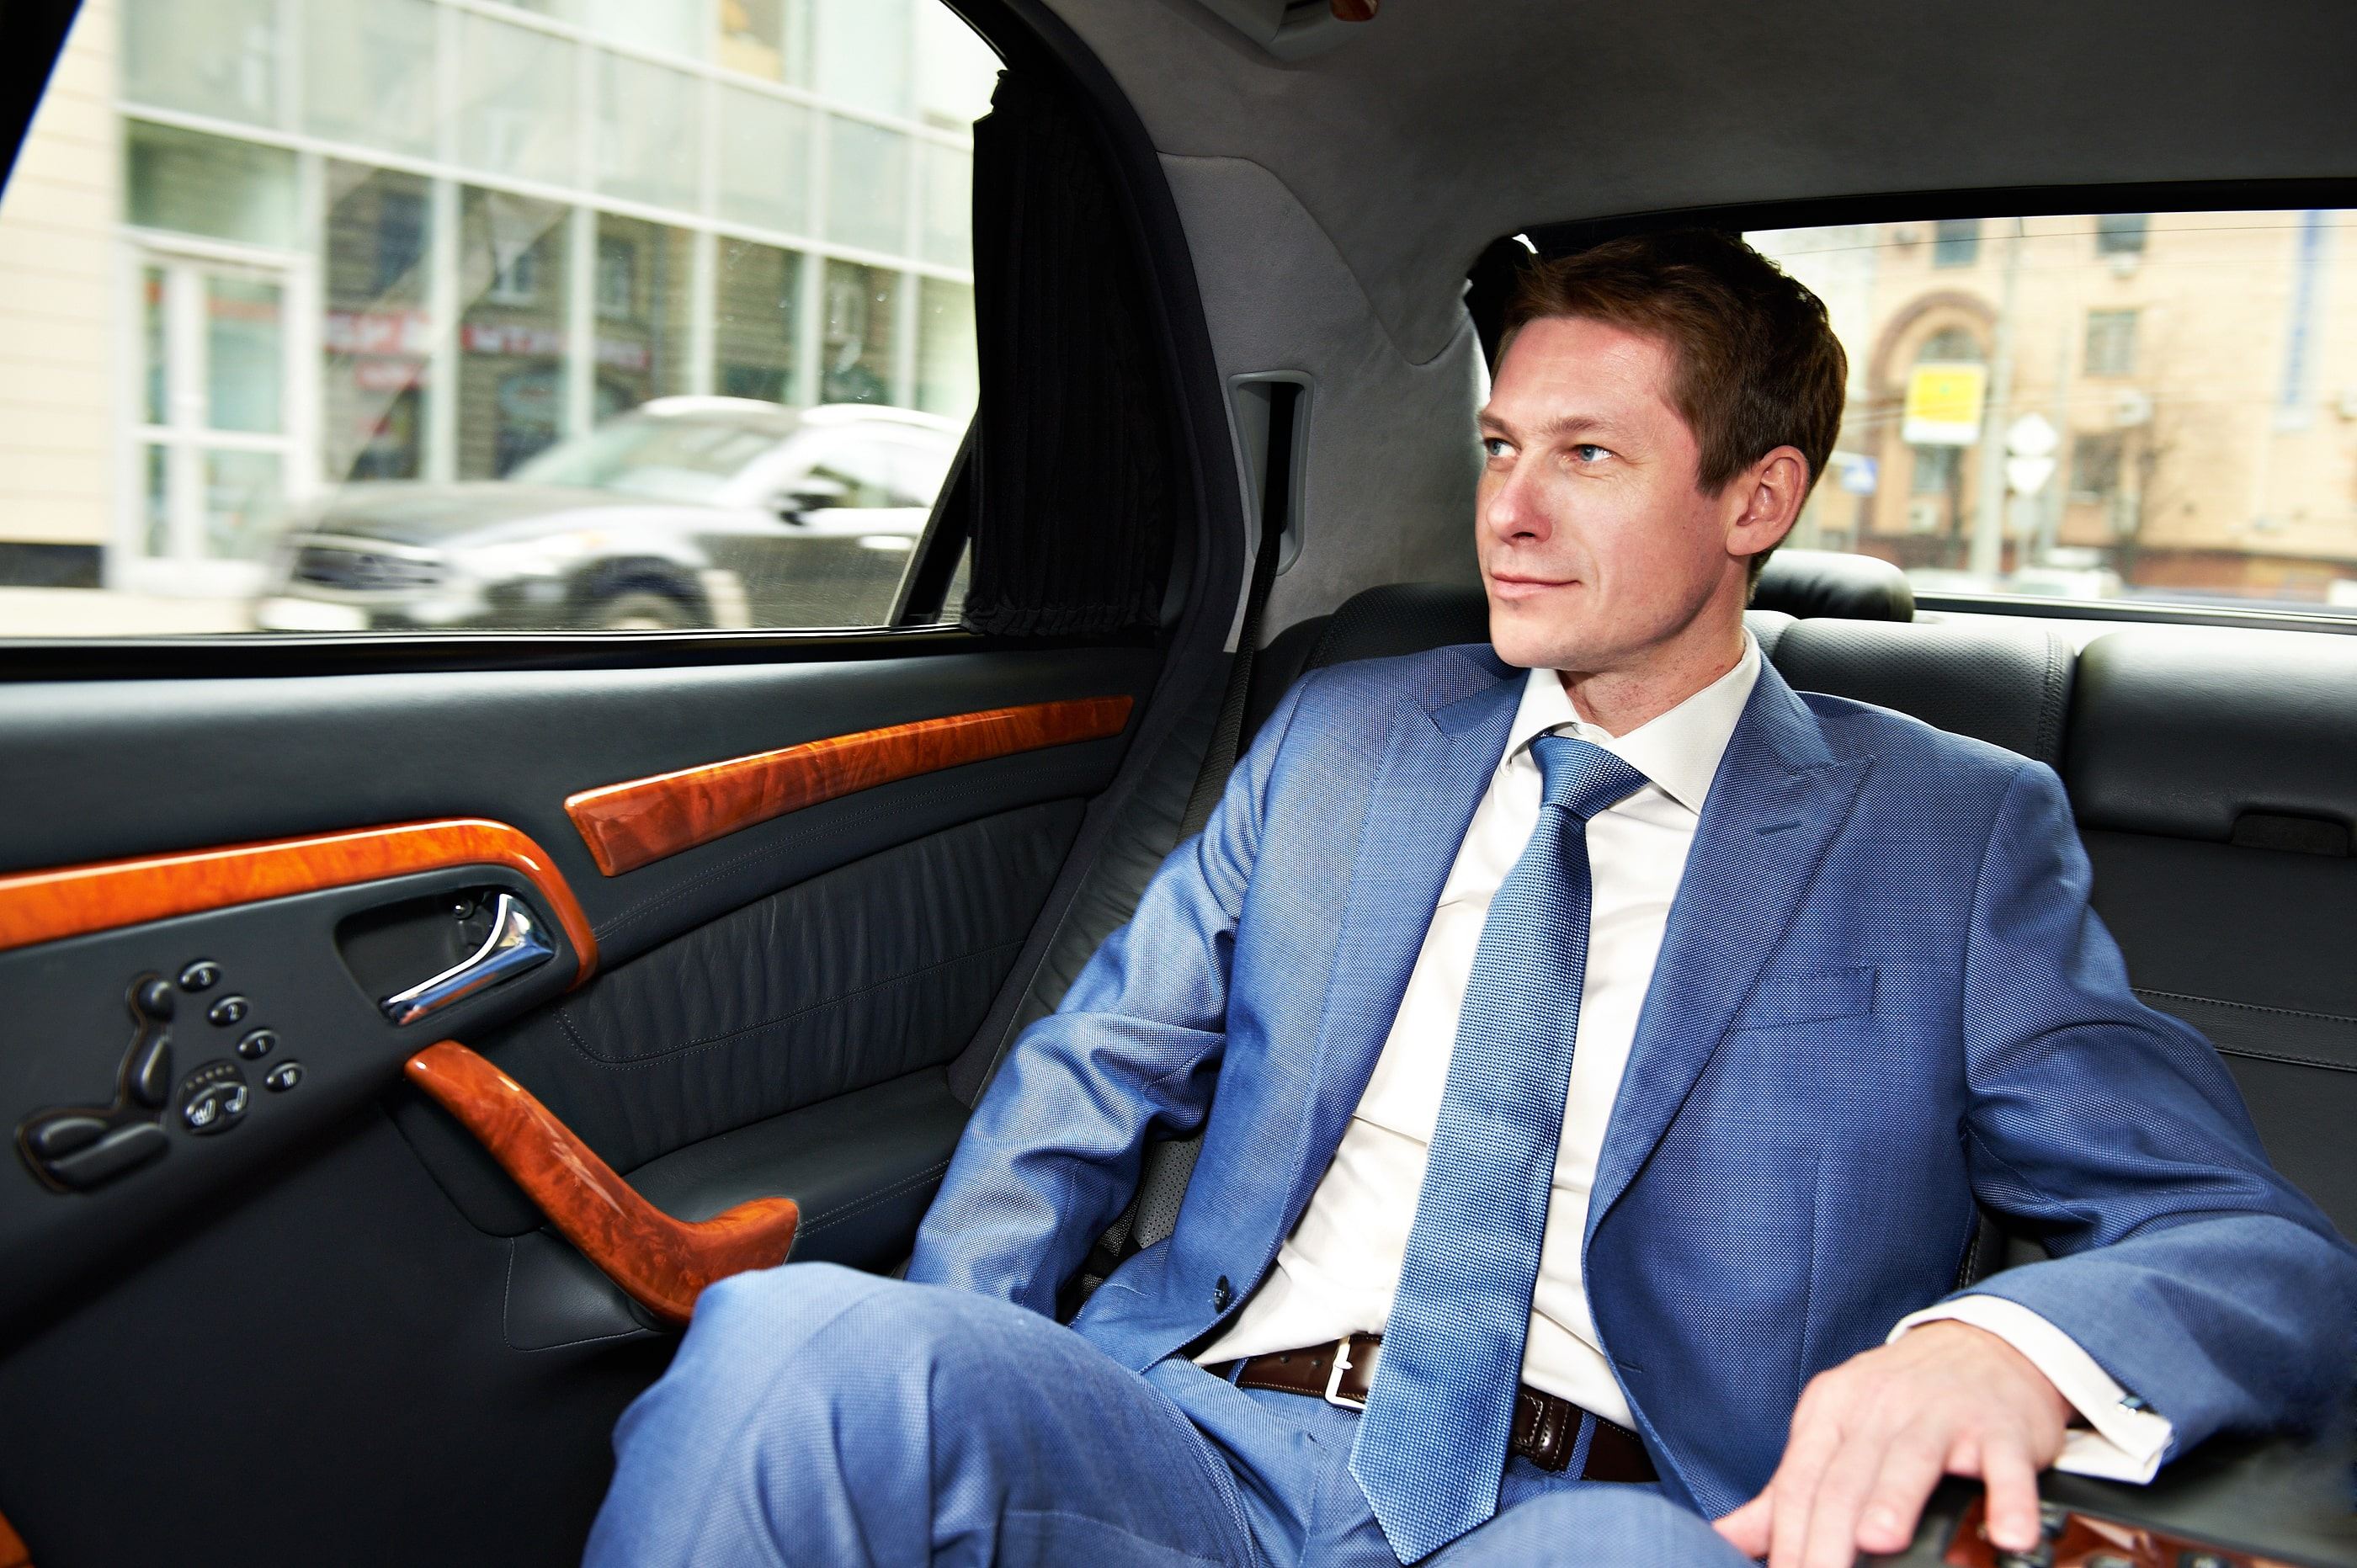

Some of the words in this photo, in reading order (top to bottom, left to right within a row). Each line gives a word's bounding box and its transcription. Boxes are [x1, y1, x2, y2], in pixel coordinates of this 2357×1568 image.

[200, 969, 211, 985] 3
[228, 1004, 239, 1021] 2
[283, 1070, 296, 1087] M
